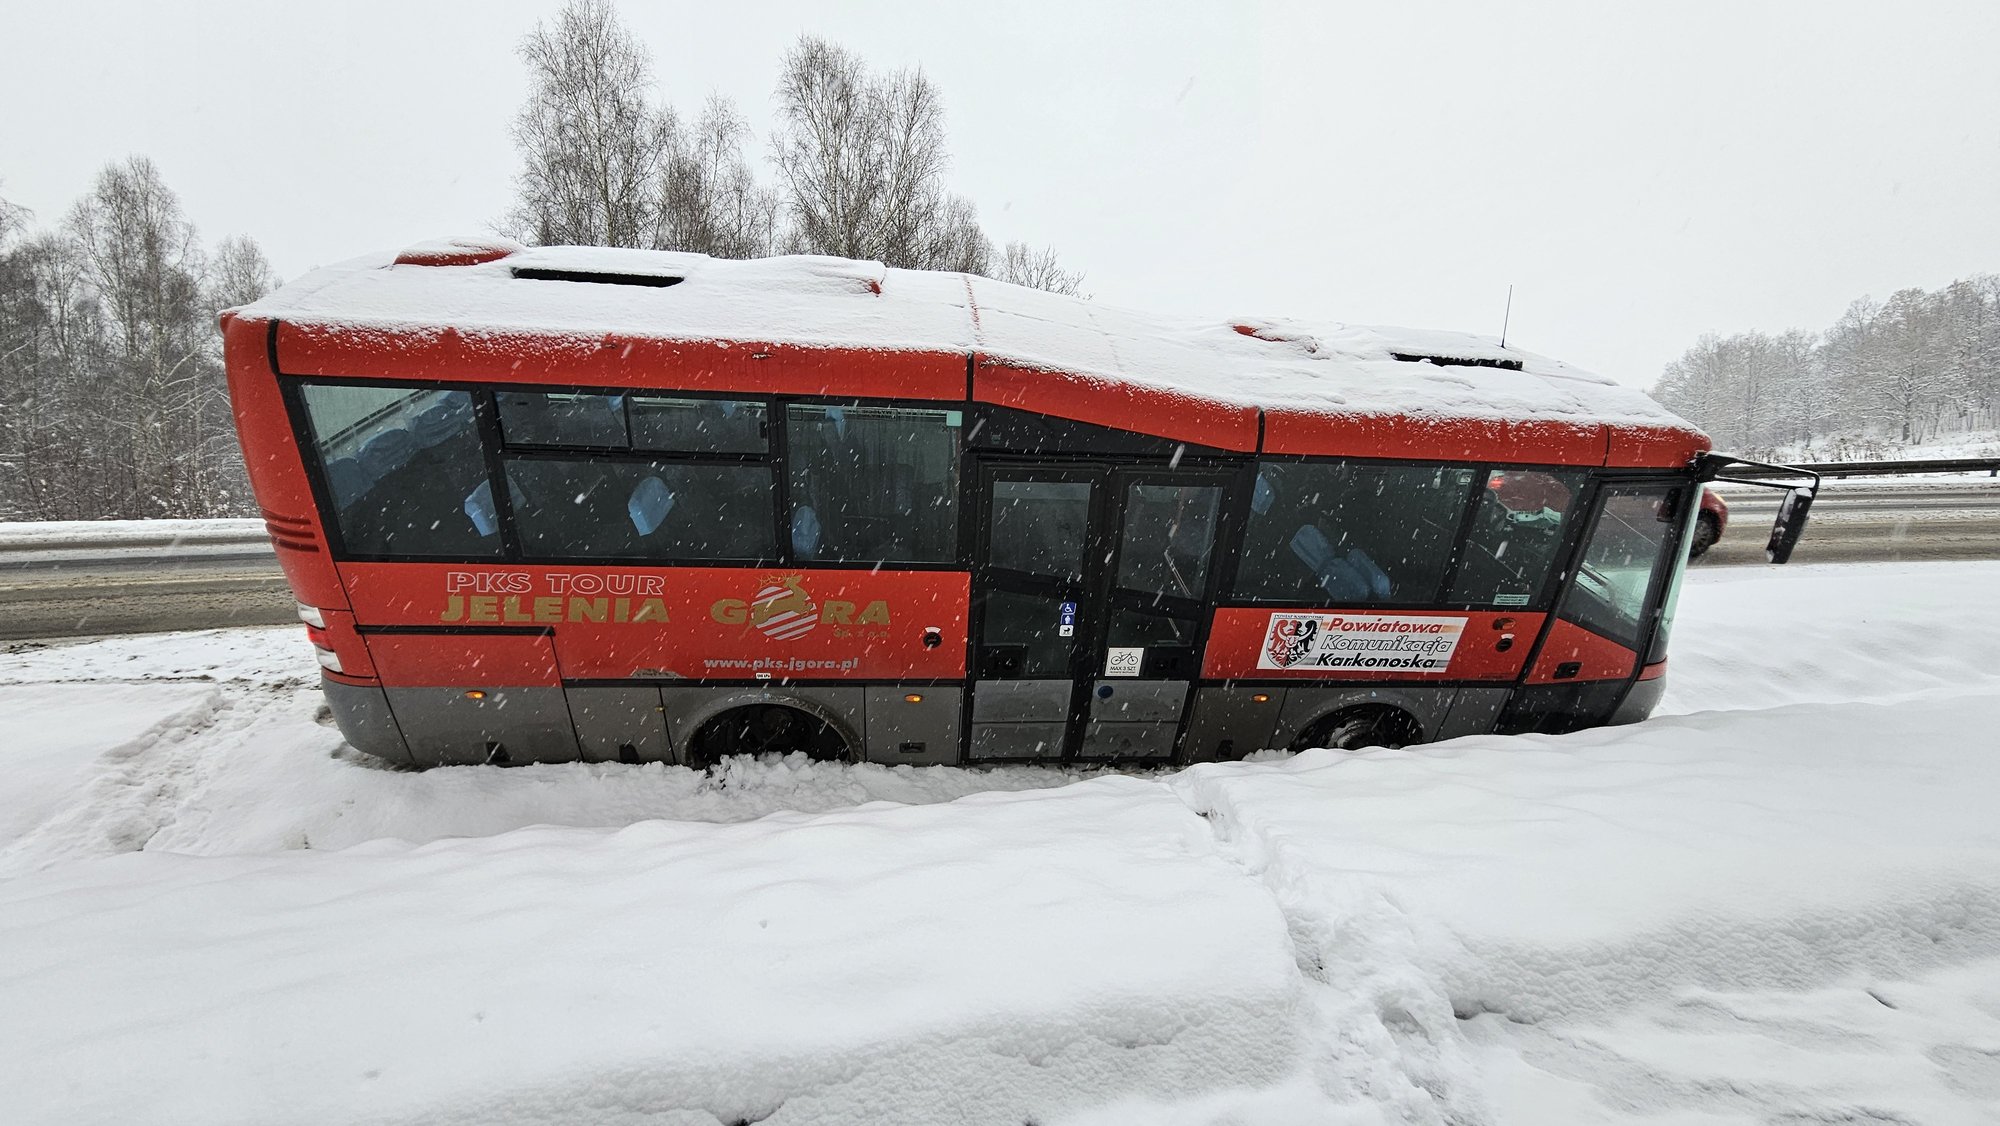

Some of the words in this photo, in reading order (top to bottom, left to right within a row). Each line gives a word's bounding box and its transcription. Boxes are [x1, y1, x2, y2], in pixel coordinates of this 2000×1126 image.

[447, 572, 532, 593] PKS
[546, 573, 666, 595] TOUR
[440, 595, 670, 623] JELENIA
[1328, 617, 1443, 634] Powiatowa
[1320, 635, 1453, 656] Komunikacja
[704, 657, 859, 671] www.pks.jgora.pl
[1316, 653, 1437, 668] Karkonoska
